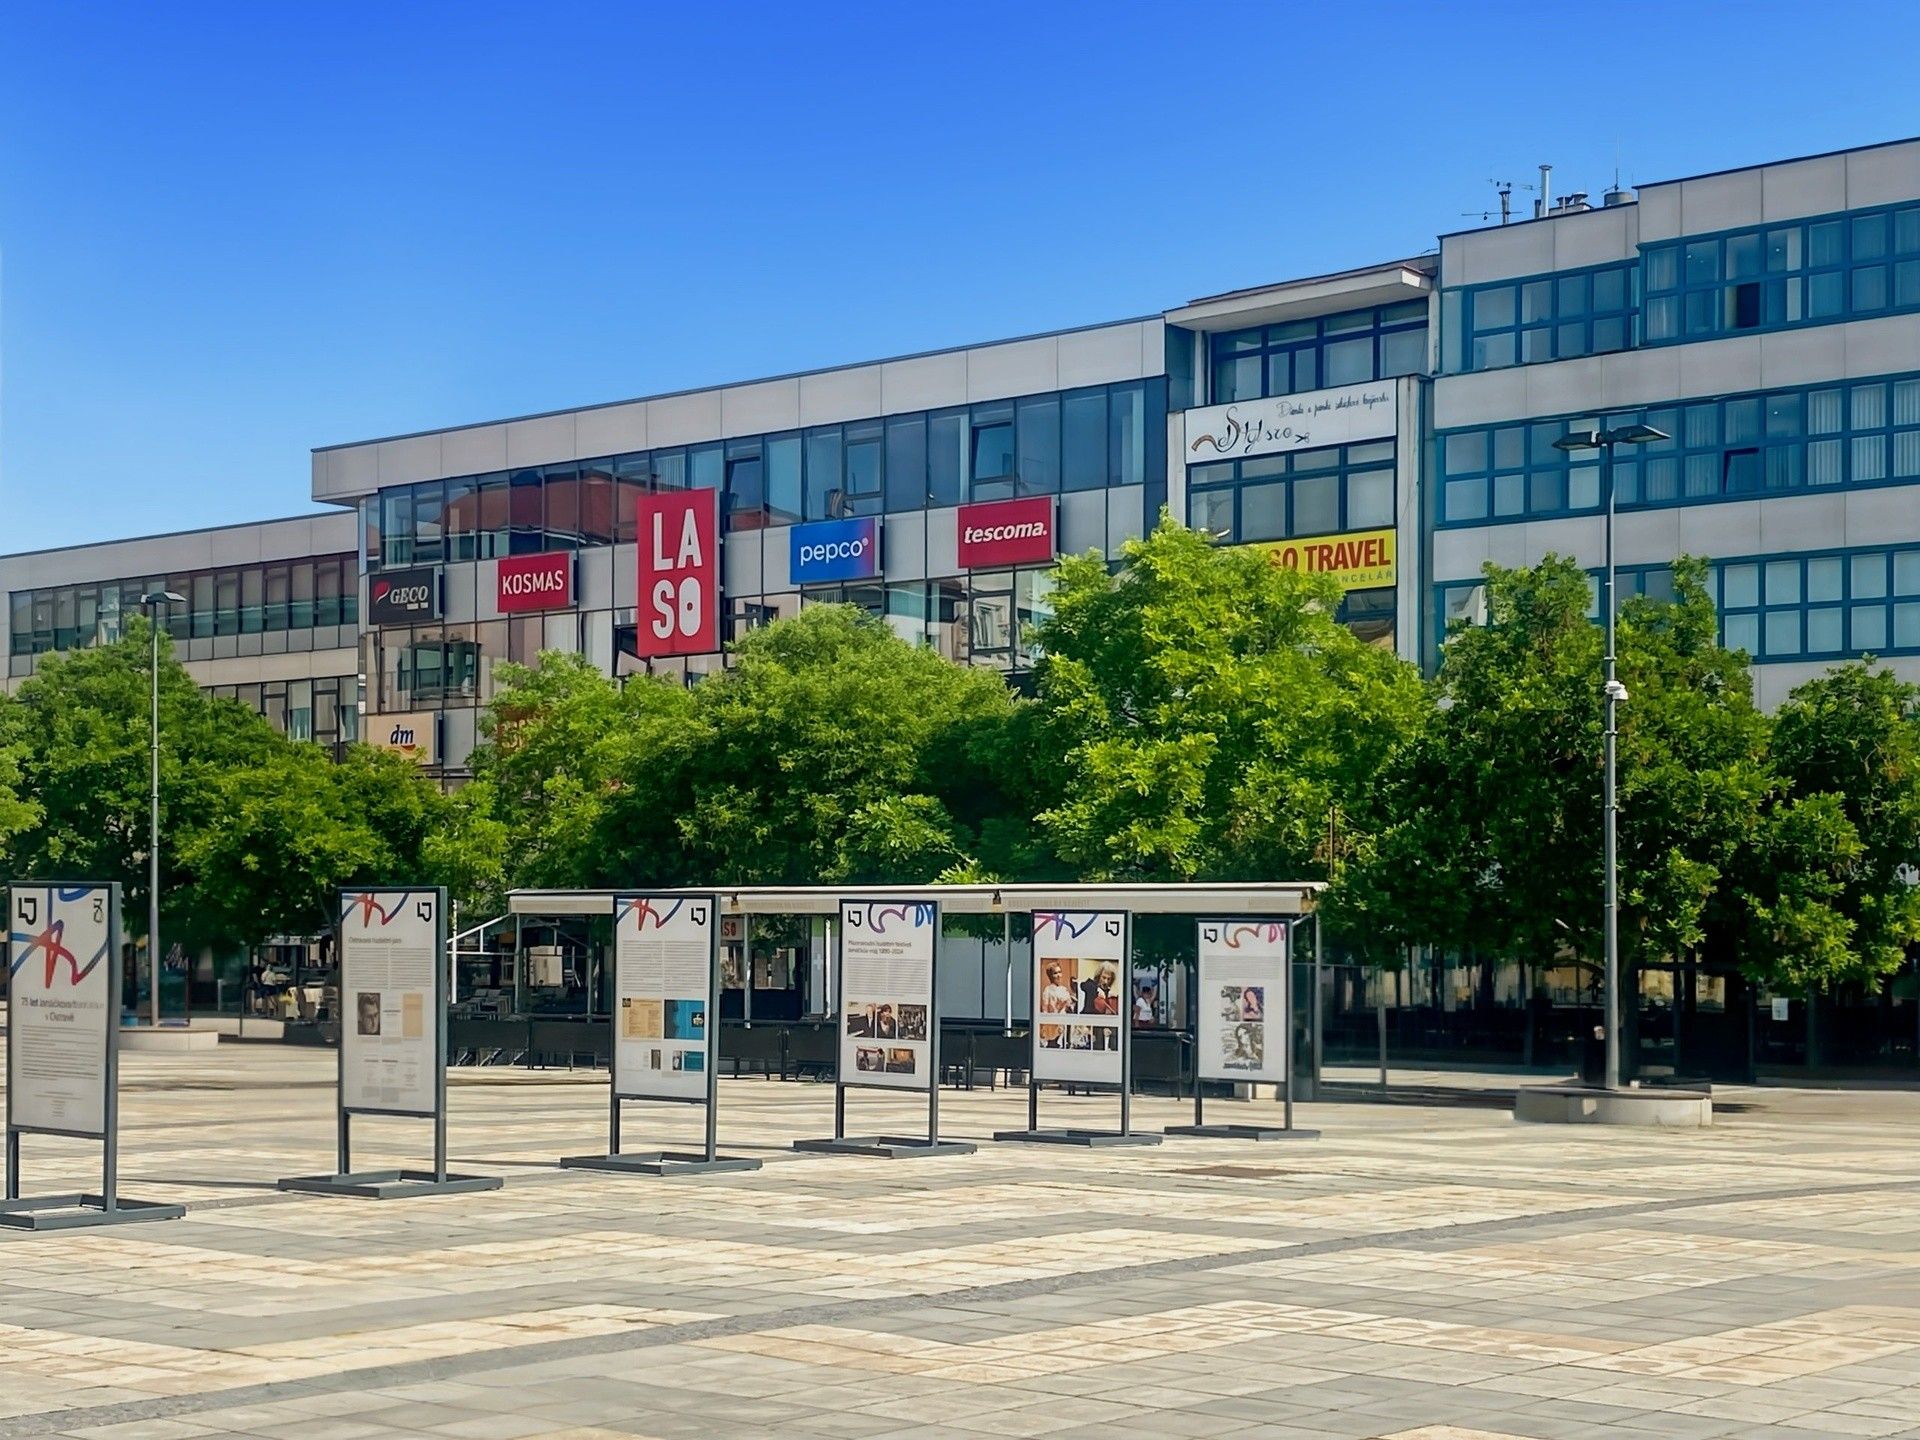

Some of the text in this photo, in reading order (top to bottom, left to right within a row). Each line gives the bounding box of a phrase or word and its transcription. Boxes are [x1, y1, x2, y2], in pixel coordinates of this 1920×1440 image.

[652, 508, 703, 572] LA
[1304, 538, 1391, 572] TRAVEL
[390, 585, 429, 604] GECO
[502, 570, 564, 595] KOSMAS
[652, 576, 702, 640] SO
[390, 724, 414, 746] dm
